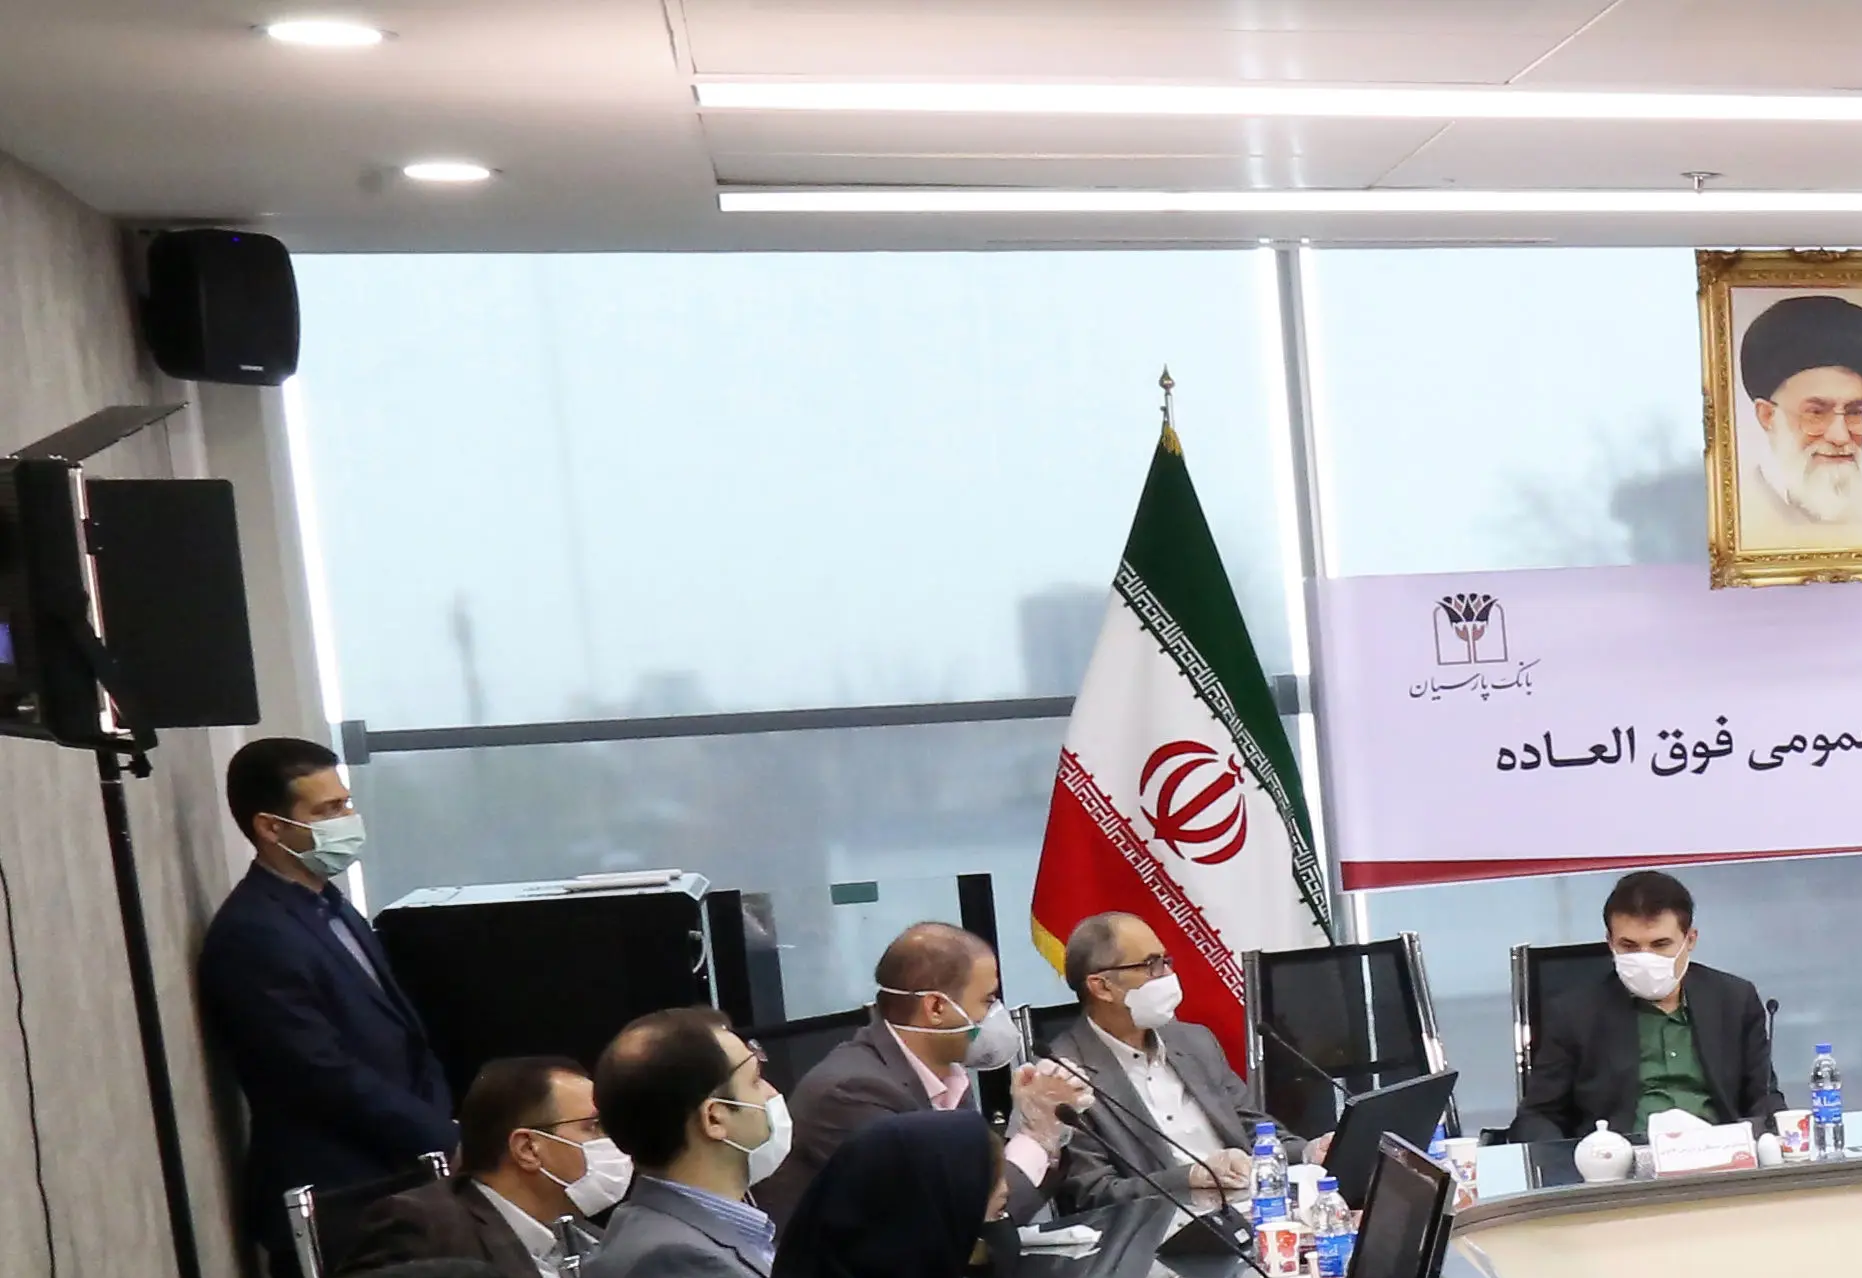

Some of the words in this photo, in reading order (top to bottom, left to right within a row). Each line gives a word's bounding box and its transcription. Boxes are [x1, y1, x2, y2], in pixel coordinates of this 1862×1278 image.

[1408, 672, 1490, 701] پارسیان
[1491, 658, 1541, 695] بانک
[1496, 725, 1636, 772] العاده
[1650, 715, 1735, 778] فوق
